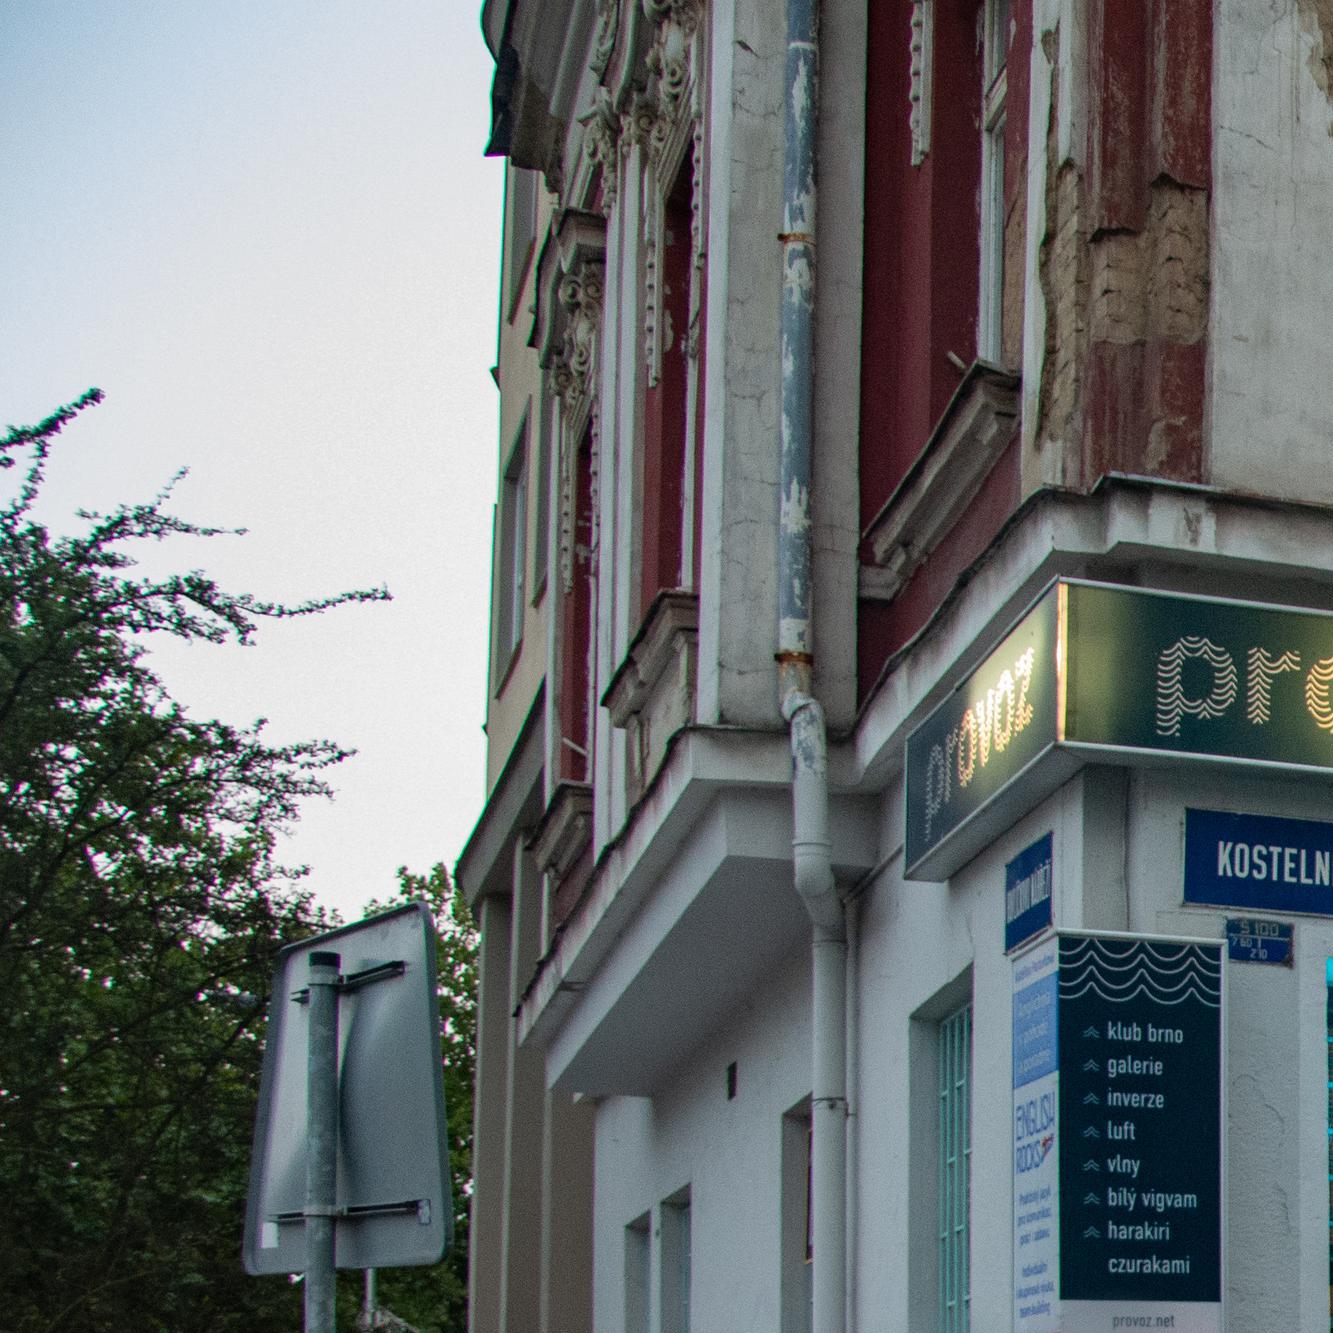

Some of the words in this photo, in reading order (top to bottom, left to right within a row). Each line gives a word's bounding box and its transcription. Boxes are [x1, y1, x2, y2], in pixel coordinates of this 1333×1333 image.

[924, 647, 1035, 841] provoz
[1107, 1020, 1142, 1041] klub
[1147, 1023, 1184, 1043] brno
[1107, 1055, 1163, 1078] galerie
[1107, 1087, 1165, 1108] inverze
[1107, 1120, 1136, 1140] luft
[1107, 1154, 1140, 1178] vlny
[1108, 1187, 1137, 1211] bílý
[1141, 1188, 1197, 1212] vigvam
[1107, 1220, 1170, 1240] harakiri
[1108, 1254, 1190, 1274] czurakami
[1112, 1315, 1175, 1328] provoz.net
